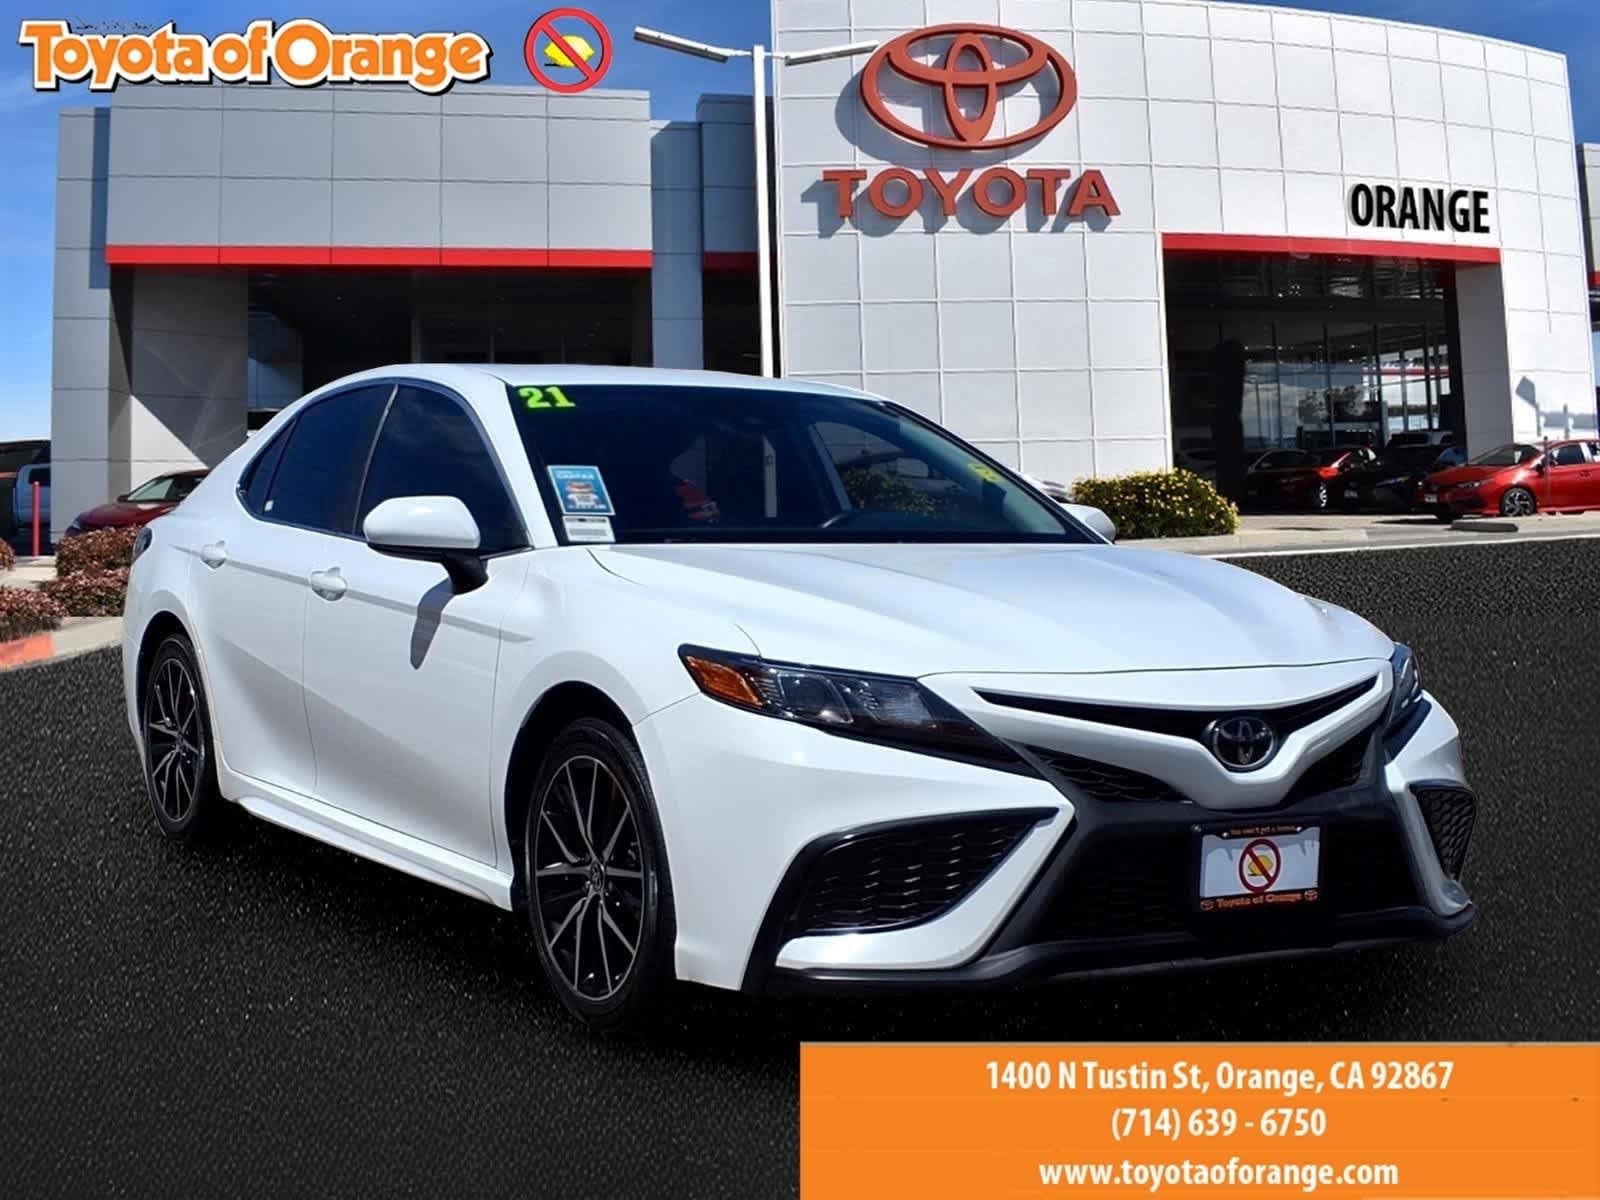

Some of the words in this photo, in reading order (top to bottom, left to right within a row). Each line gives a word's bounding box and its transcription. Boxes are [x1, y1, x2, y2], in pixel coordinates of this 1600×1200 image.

[824, 168, 1120, 218] TOYOTA
[1351, 183, 1491, 234] ORANGE
[518, 386, 576, 408] 21
[1216, 897, 1252, 908] Toyota
[1252, 894, 1264, 905] of
